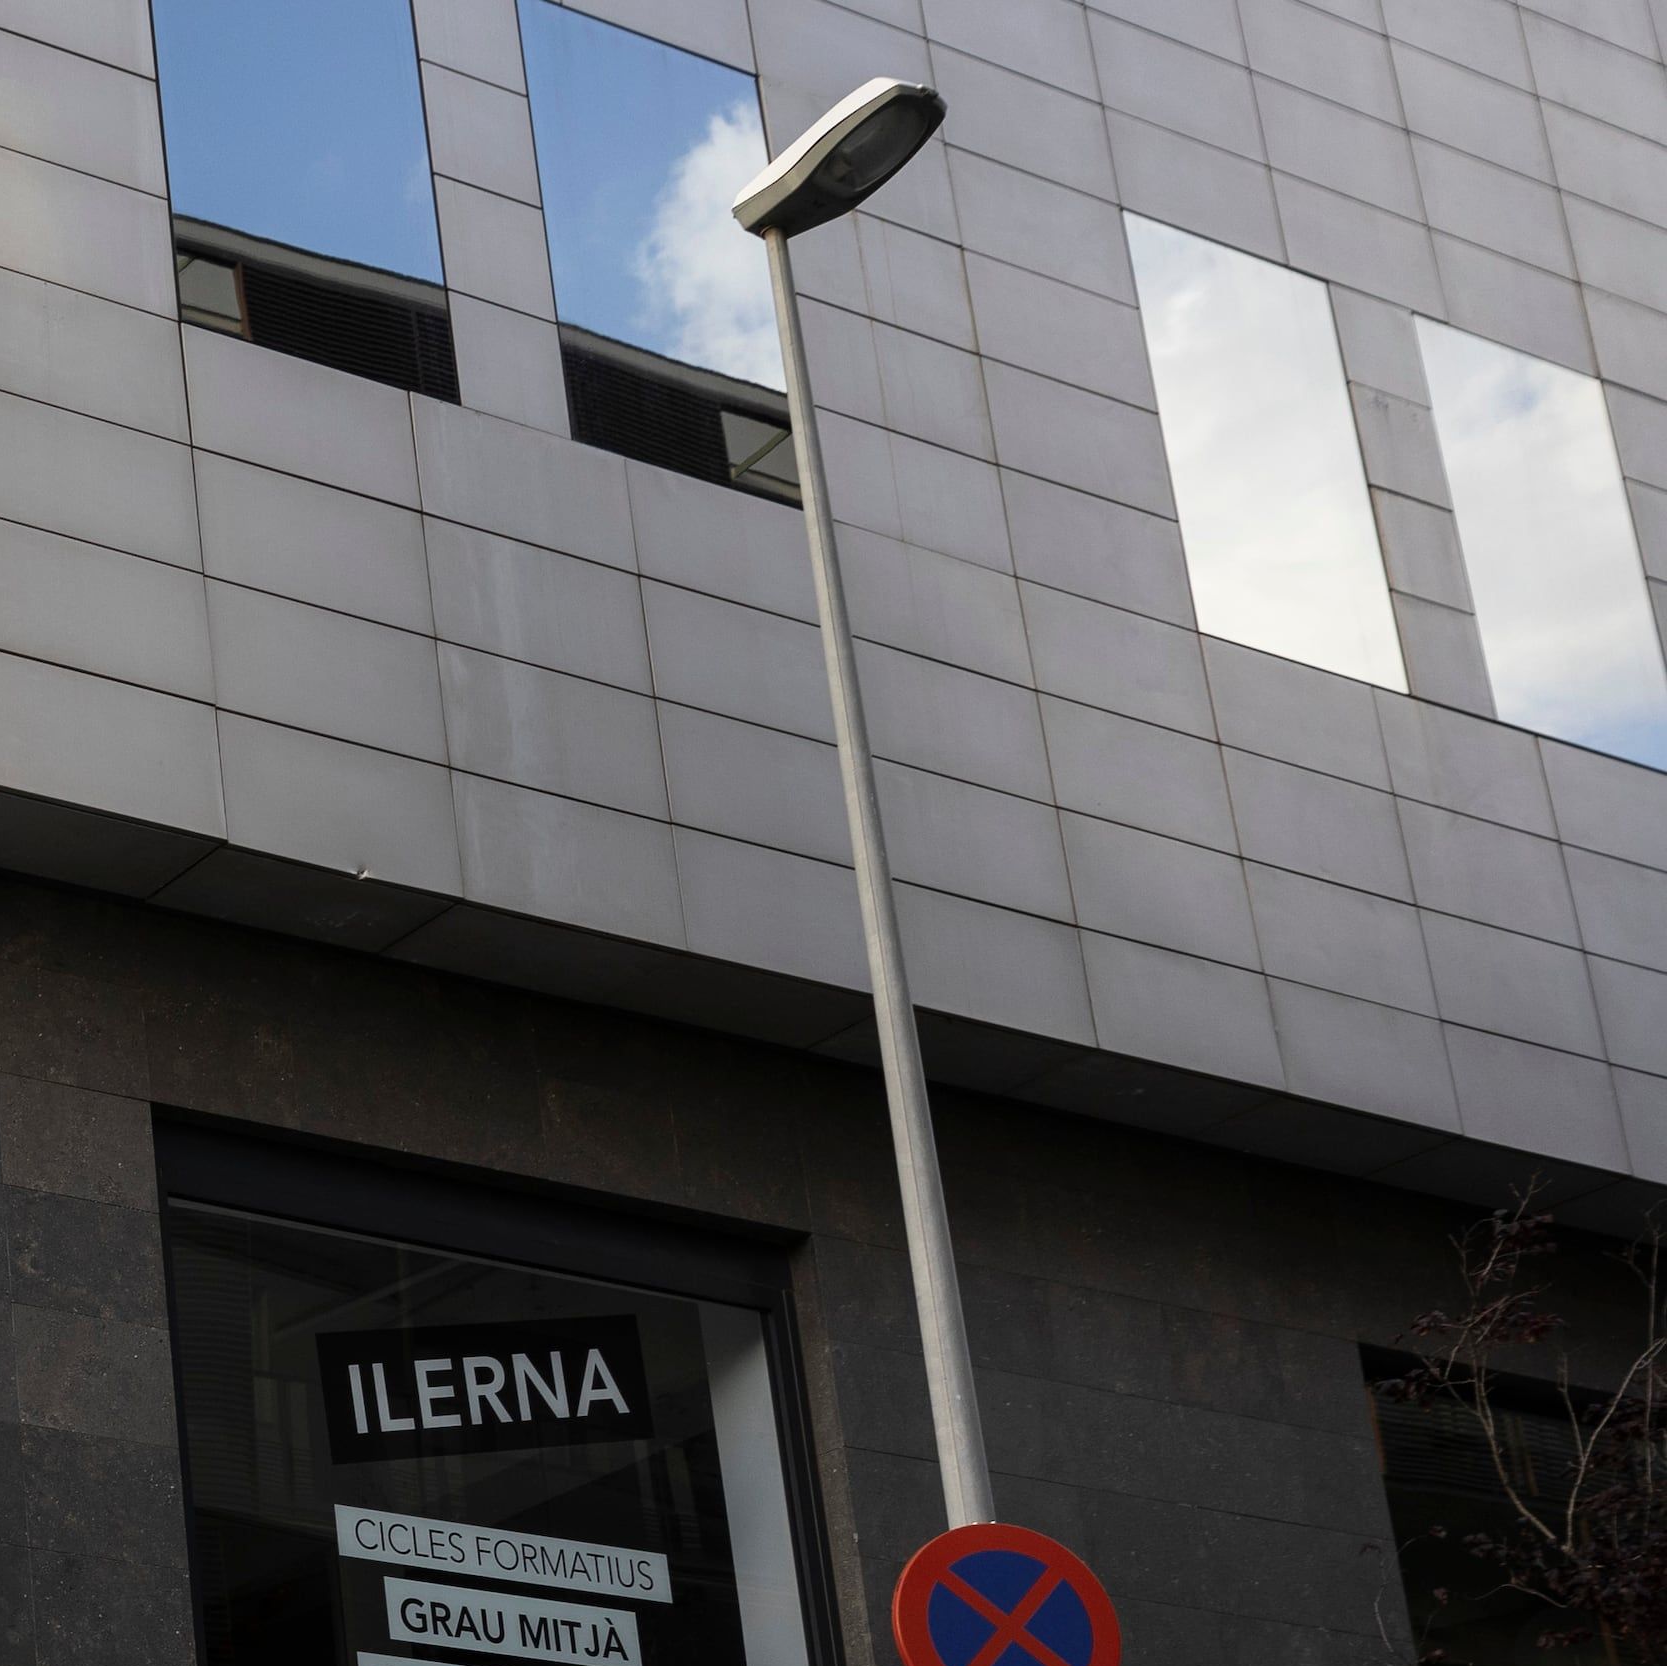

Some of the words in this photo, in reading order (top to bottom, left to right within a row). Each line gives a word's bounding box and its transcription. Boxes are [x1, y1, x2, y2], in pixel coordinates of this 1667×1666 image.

[348, 1348, 630, 1434] ILERNA
[355, 1518, 465, 1564] CICLES
[475, 1536, 655, 1591] FORMATIUS
[400, 1597, 505, 1644] GRAU
[519, 1615, 629, 1662] MITJÀ
